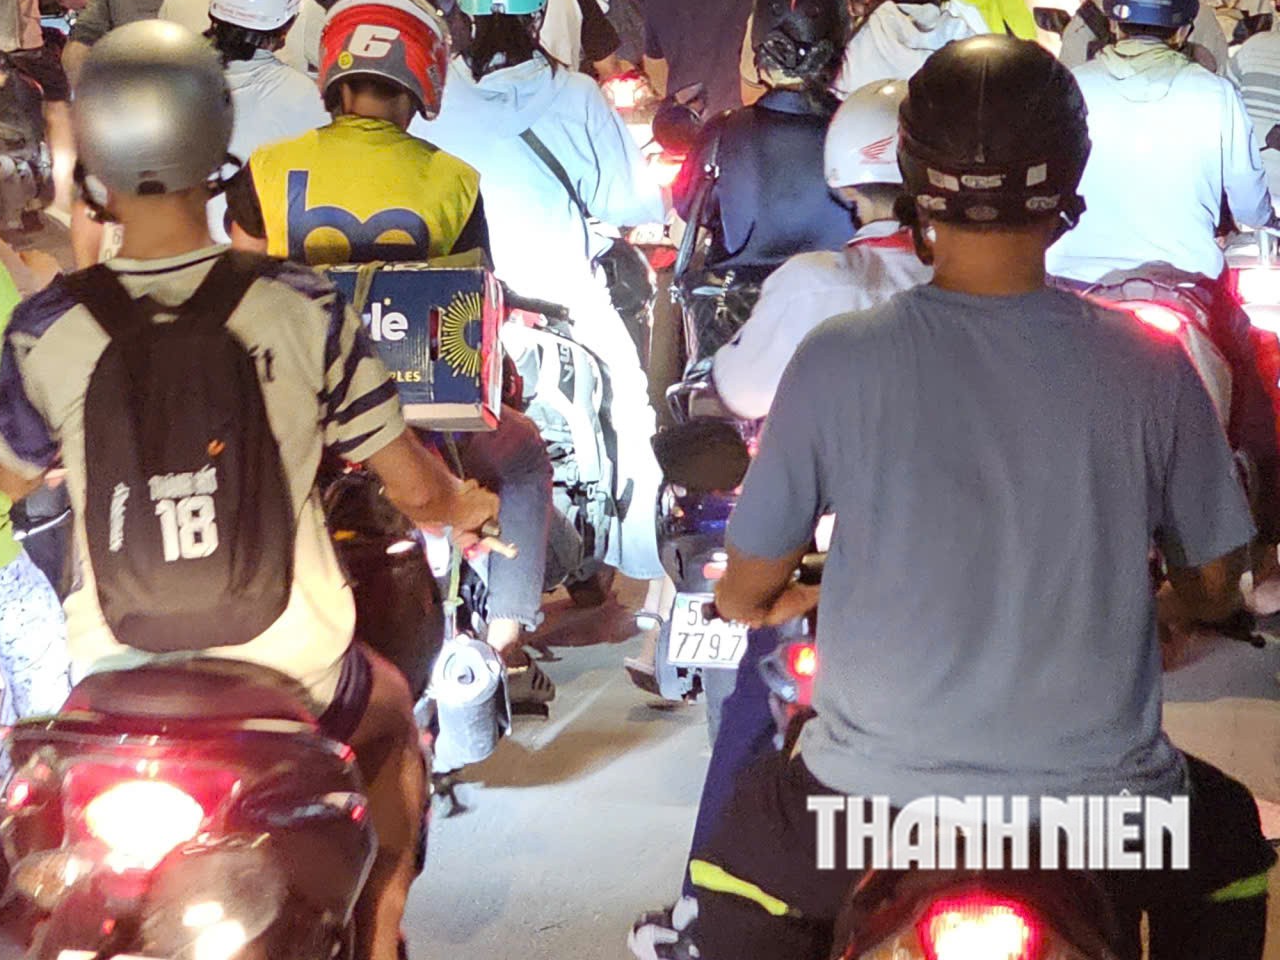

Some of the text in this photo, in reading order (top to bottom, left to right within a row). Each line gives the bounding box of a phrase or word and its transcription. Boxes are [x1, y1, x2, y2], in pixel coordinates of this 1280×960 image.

[348, 23, 401, 58] 6
[362, 303, 408, 341] le
[155, 495, 219, 562] 18
